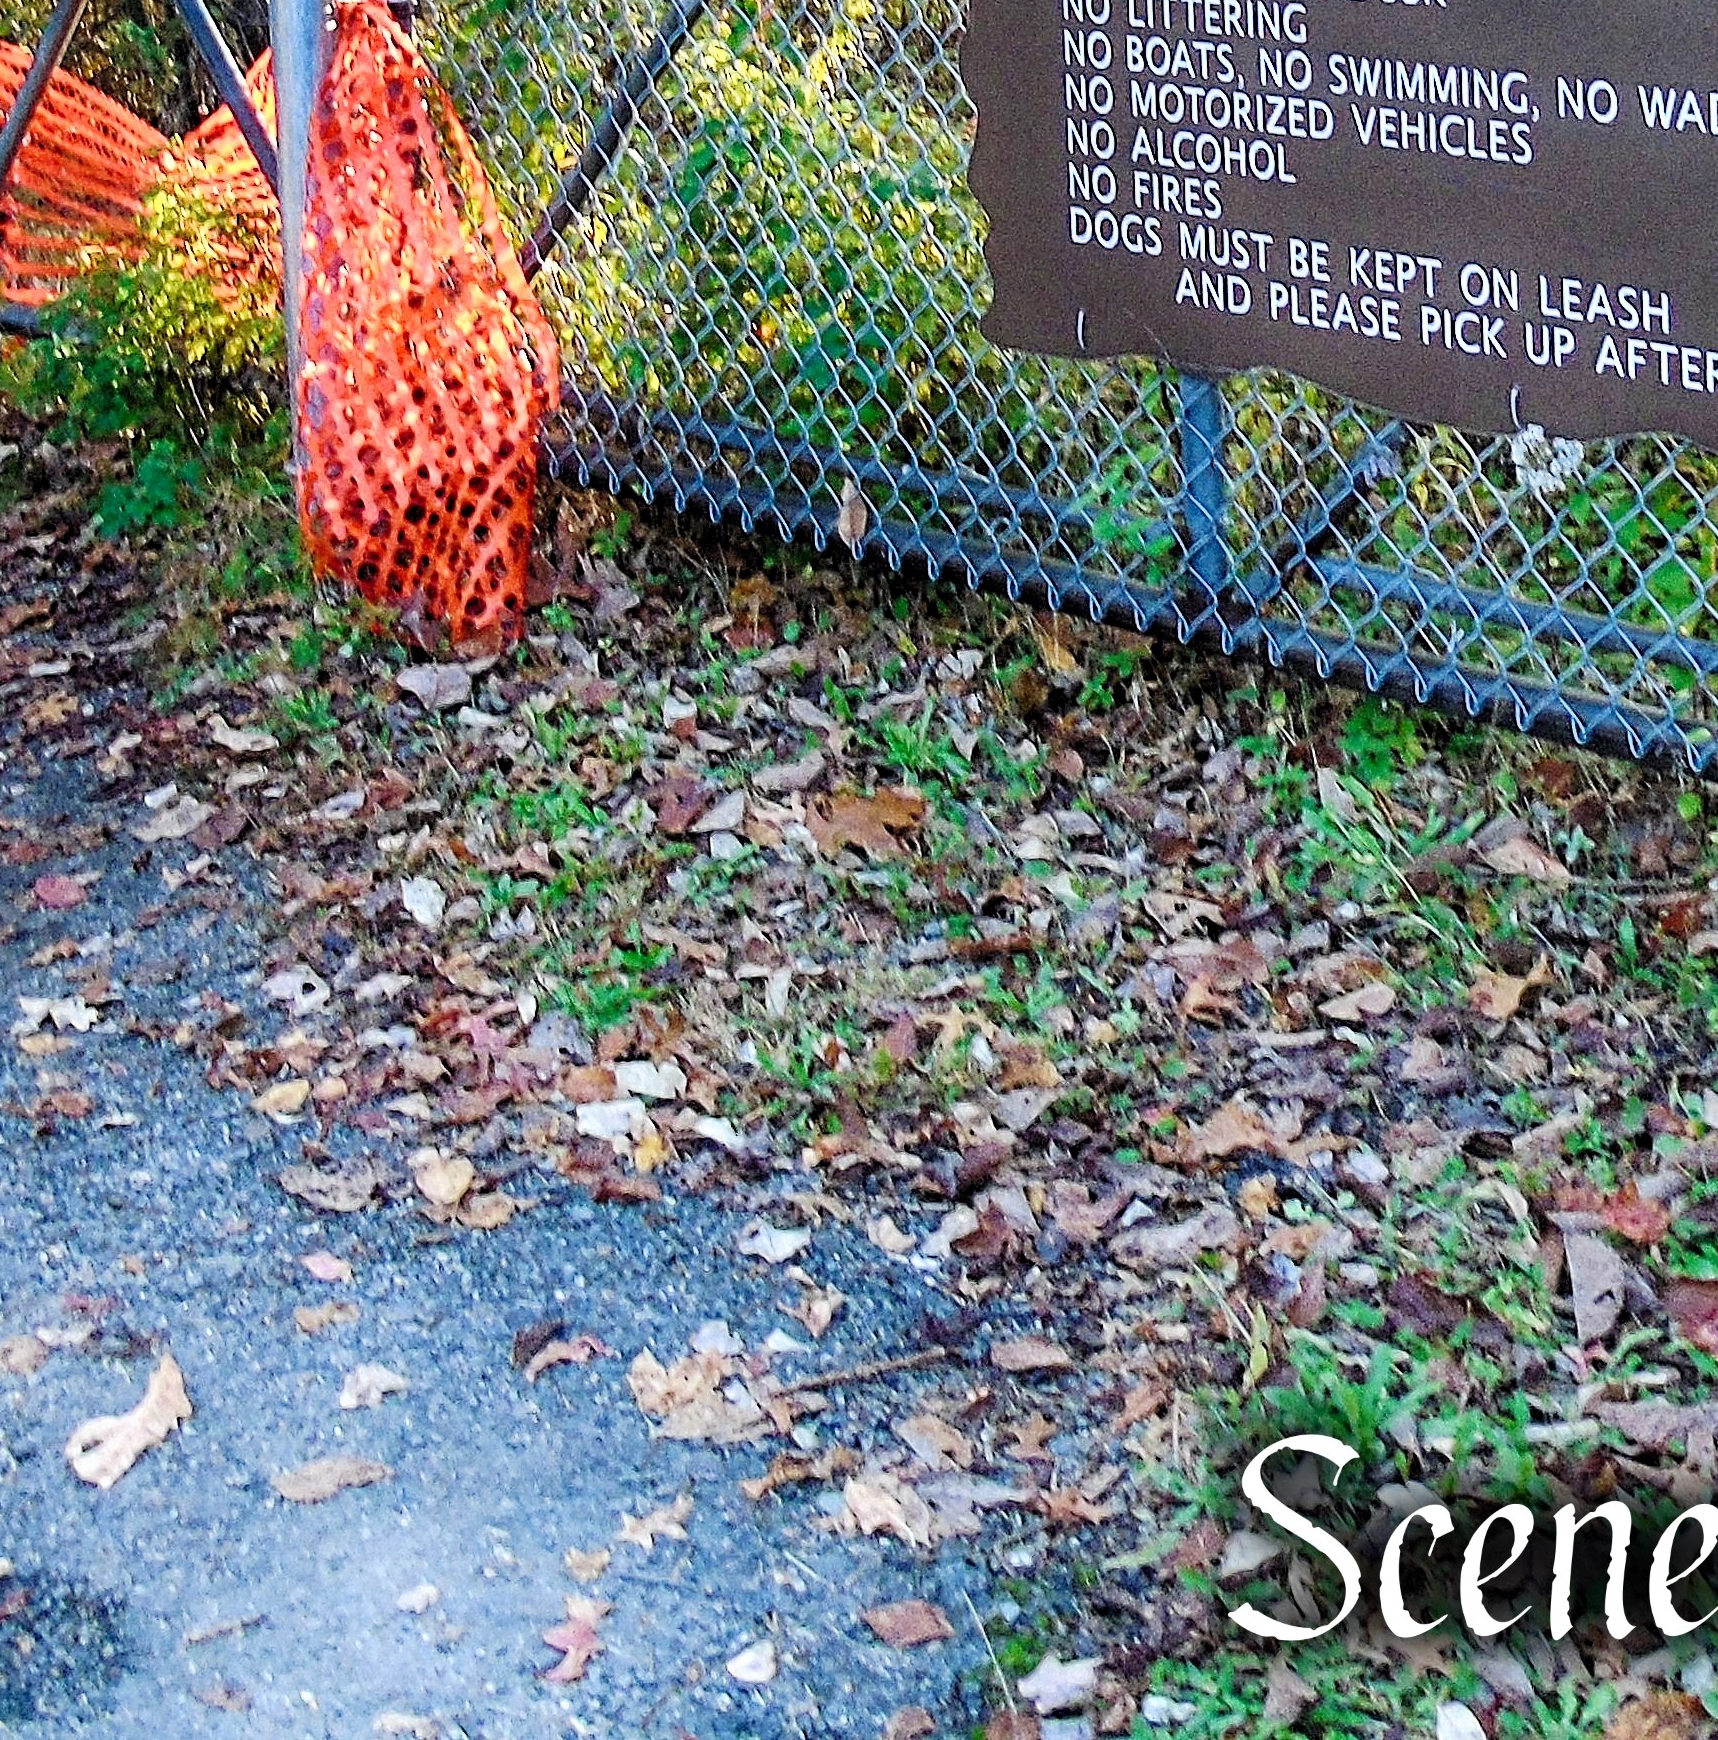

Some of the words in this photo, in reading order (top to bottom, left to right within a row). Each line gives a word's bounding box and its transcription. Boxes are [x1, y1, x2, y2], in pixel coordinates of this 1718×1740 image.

[1064, 29, 1111, 69] NO
[1127, 35, 1244, 90] BOATS,
[1260, 48, 1312, 91] NO
[1329, 54, 1539, 122] SWIMMING,
[1558, 77, 1617, 123] NO
[1066, 74, 1113, 114] NO
[1131, 81, 1333, 140] MOTORIZED
[1351, 104, 1533, 164] VEHICLES
[1067, 118, 1114, 159] NO
[1132, 126, 1297, 184] ALCOHOL
[1069, 162, 1116, 203] NO
[1134, 171, 1221, 219] FIRES
[1070, 206, 1162, 255] DOGS
[1180, 222, 1273, 272] MUST
[1290, 238, 1330, 282] BE
[1350, 247, 1442, 298] KEPT
[1461, 264, 1519, 311] ON
[1540, 275, 1669, 334] LEASH
[1176, 268, 1251, 314] AND
[1270, 282, 1401, 340] PLEASE
[1421, 306, 1507, 358] PICK
[1525, 323, 1574, 367] UP
